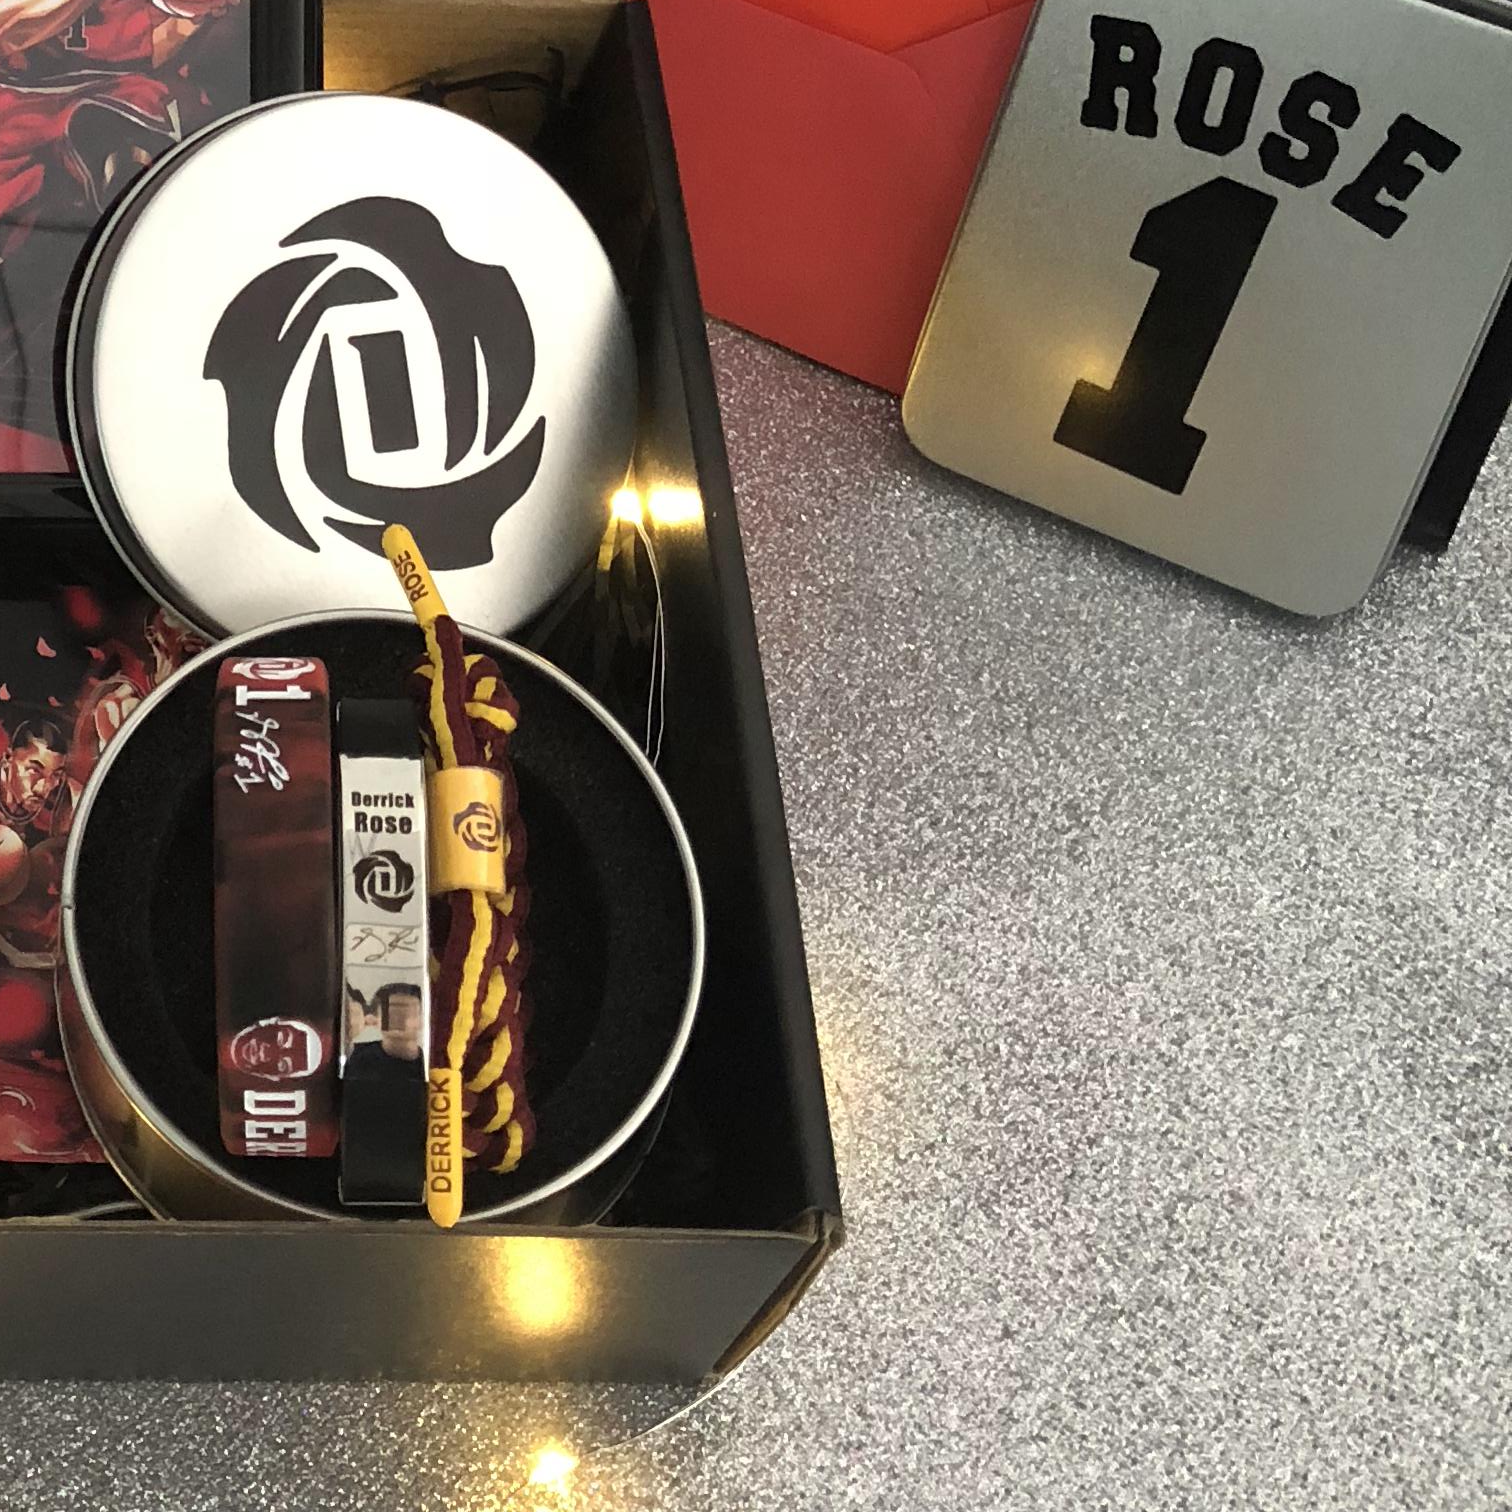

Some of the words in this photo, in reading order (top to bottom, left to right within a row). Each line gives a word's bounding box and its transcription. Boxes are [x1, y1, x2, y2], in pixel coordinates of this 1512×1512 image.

[1080, 14, 1462, 240] ROSE
[1053, 176, 1279, 496] 1
[393, 549, 429, 602] ROSE
[350, 791, 415, 809] Derrick
[354, 811, 413, 835] Rose
[430, 1076, 452, 1193] DERRICK
